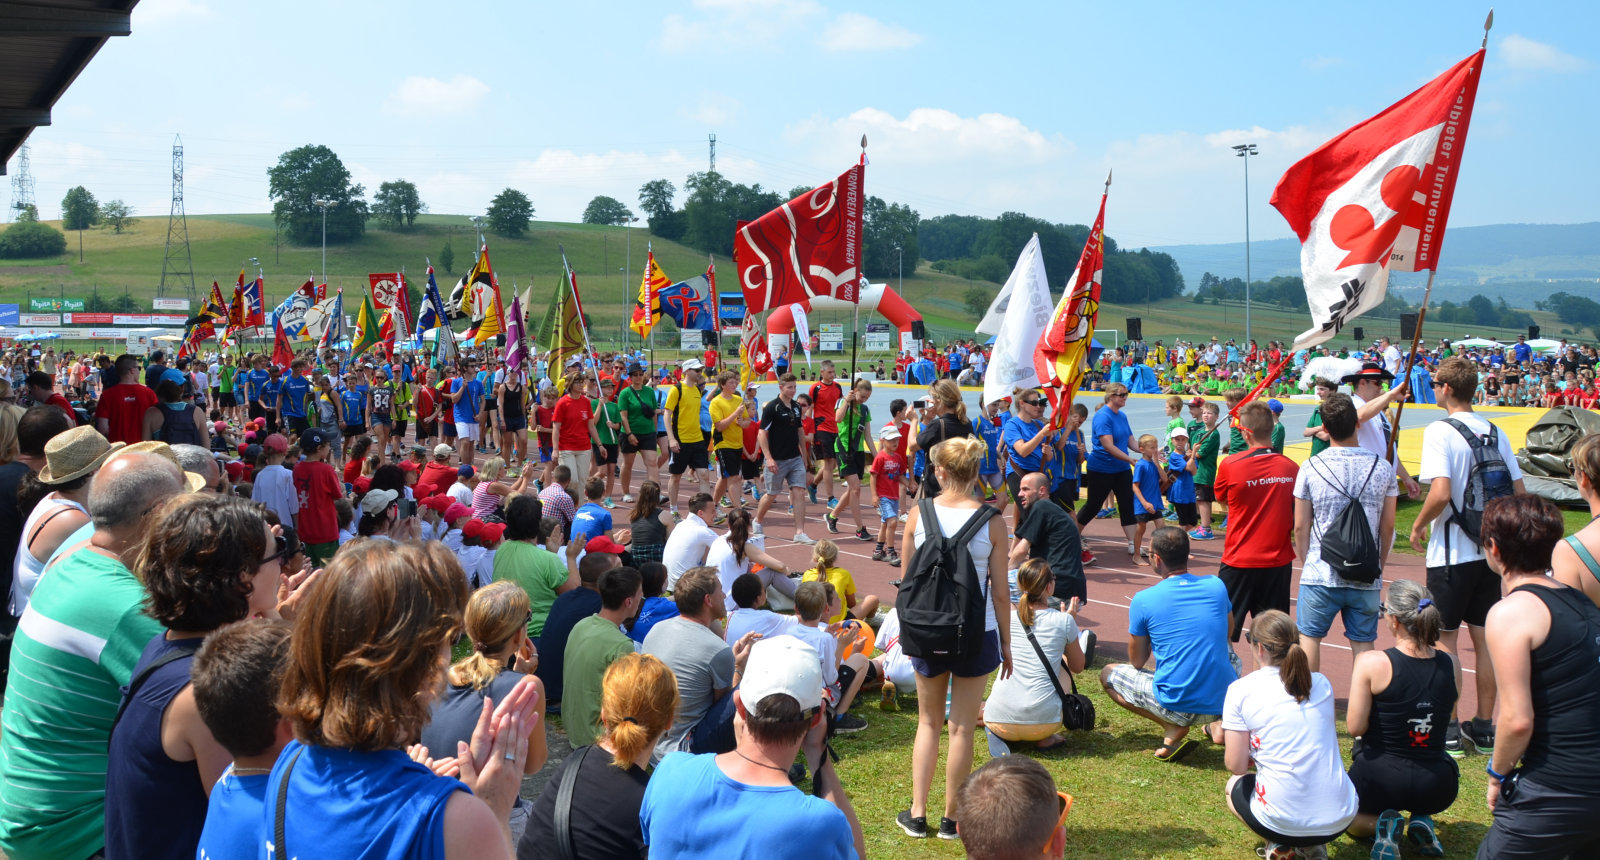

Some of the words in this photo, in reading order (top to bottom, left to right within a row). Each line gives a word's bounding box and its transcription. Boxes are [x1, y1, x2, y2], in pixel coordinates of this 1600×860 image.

[846, 219, 856, 265] ZEGLINGEN
[1391, 254, 1404, 262] 014
[844, 283, 853, 301] 1920
[31, 299, 50, 308] Pepita
[64, 300, 83, 309] Pepita
[374, 394, 389, 408] 84
[1259, 477, 1293, 485] Dittingen
